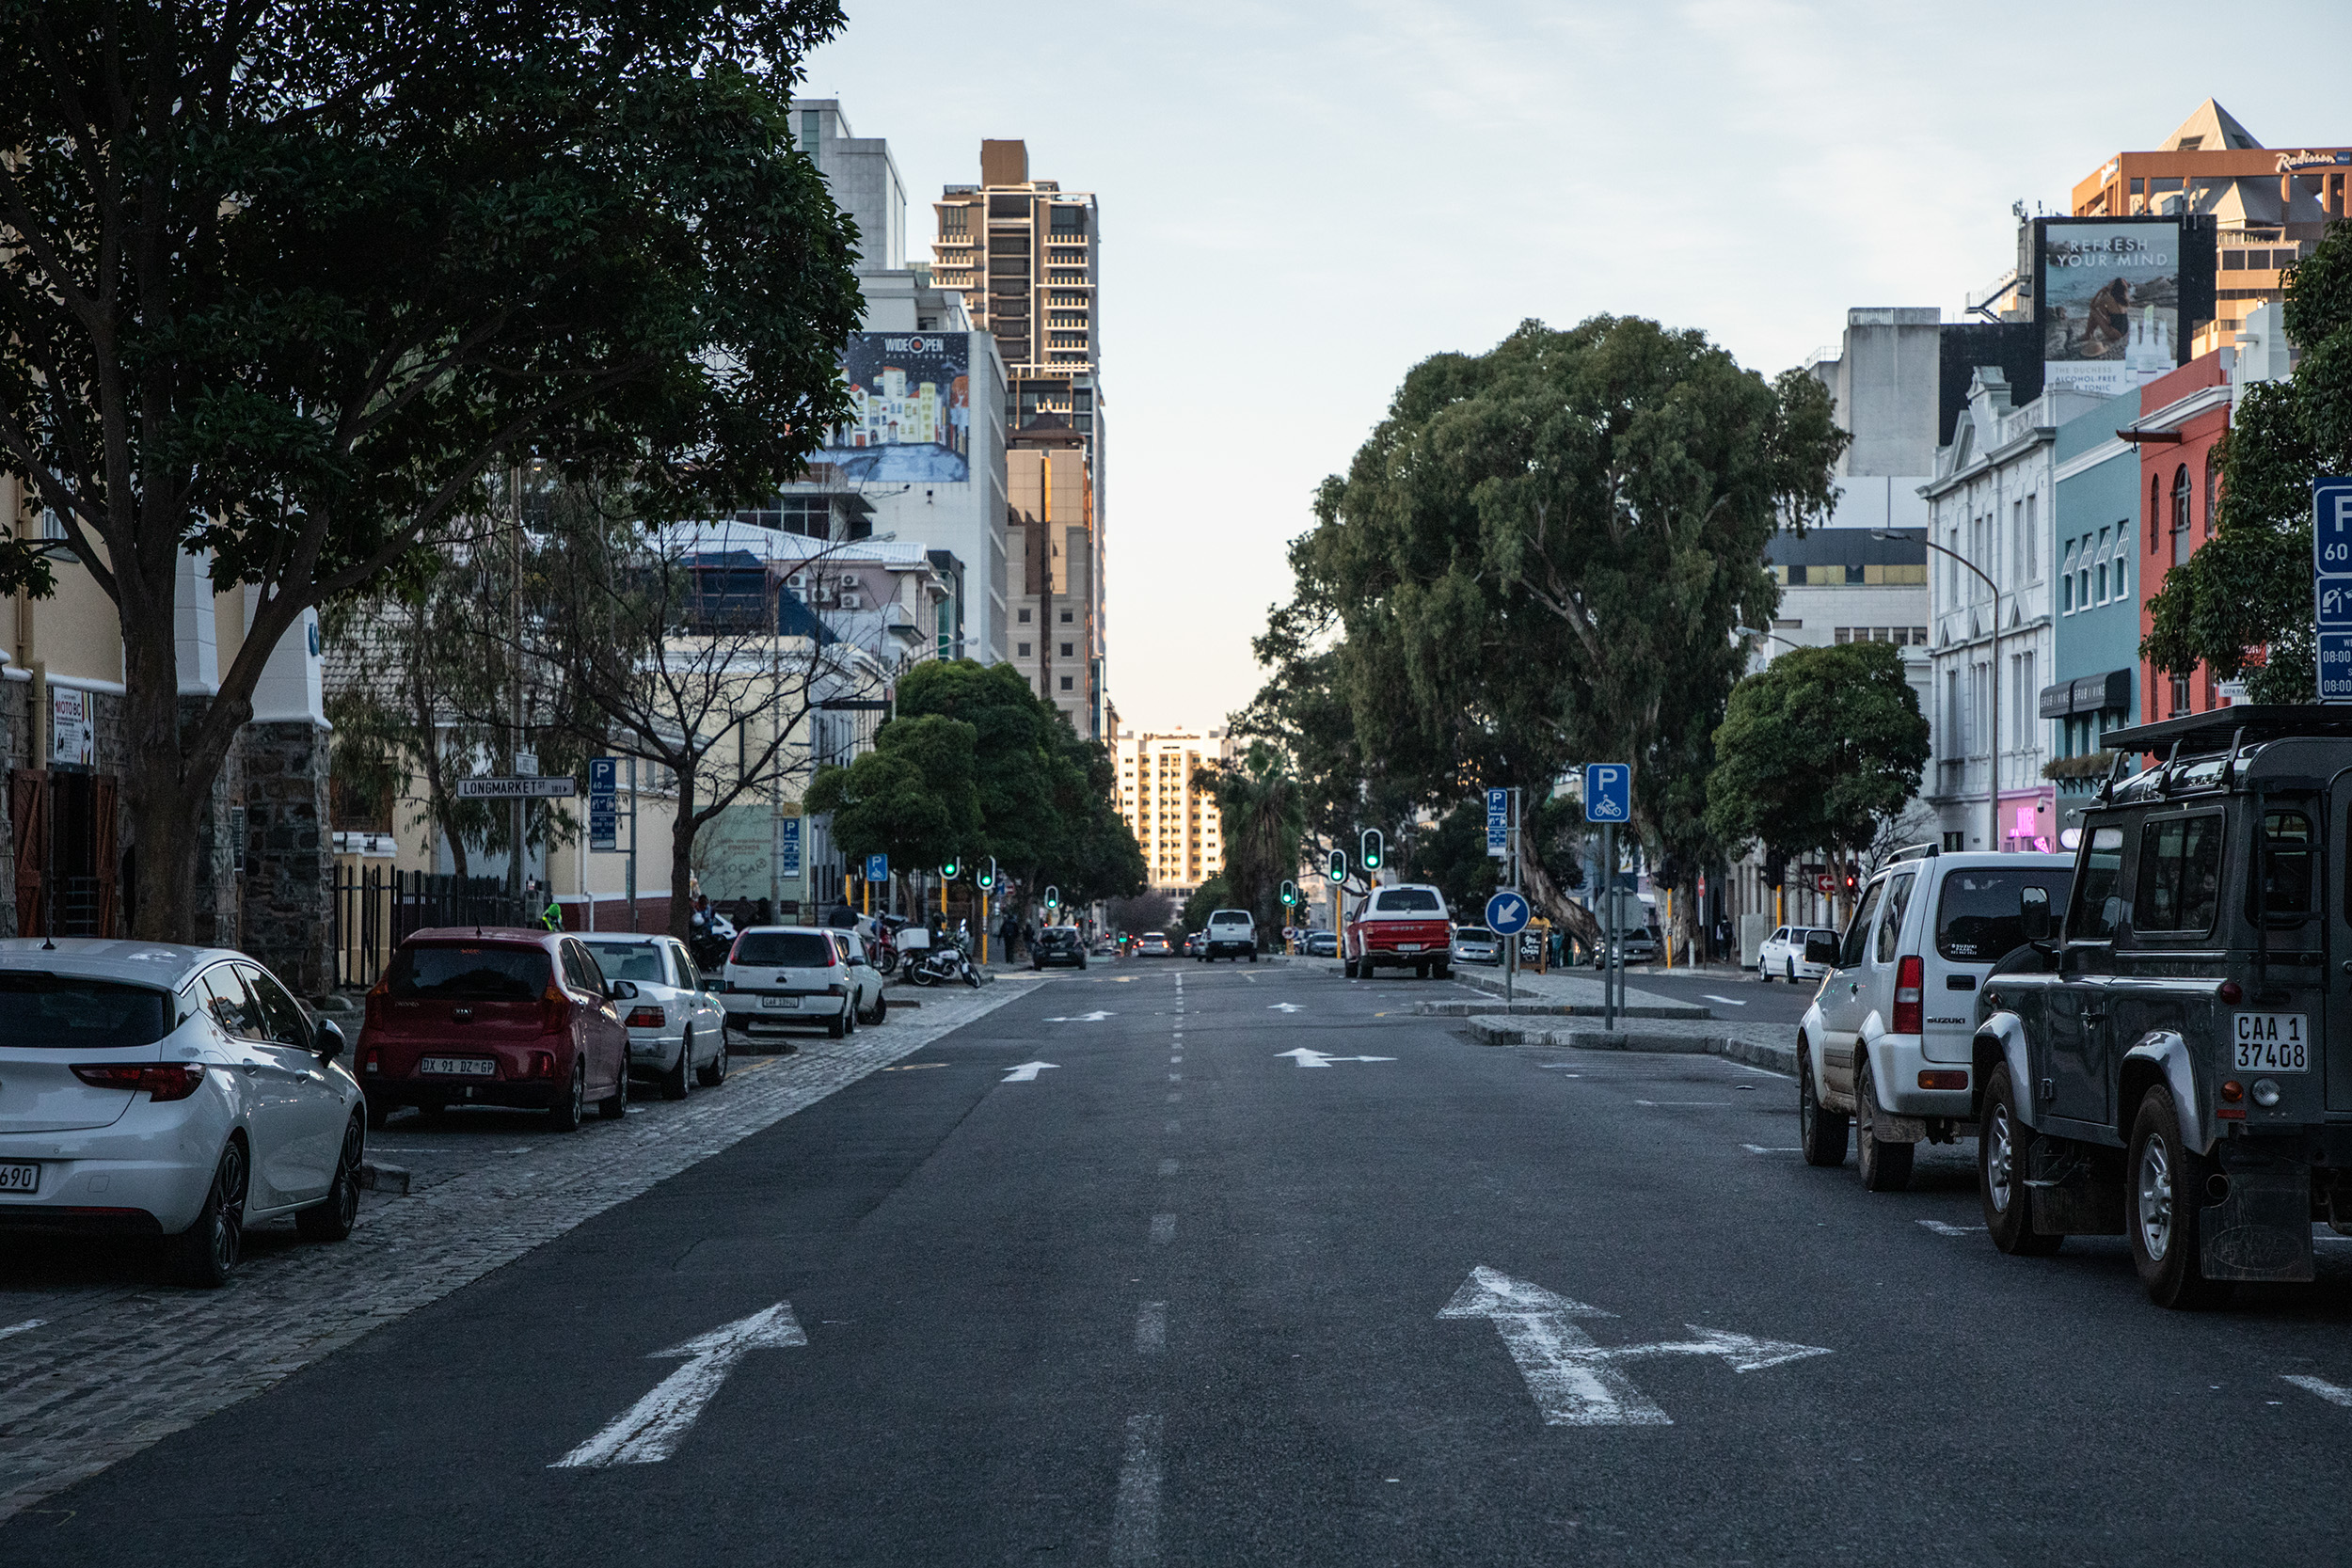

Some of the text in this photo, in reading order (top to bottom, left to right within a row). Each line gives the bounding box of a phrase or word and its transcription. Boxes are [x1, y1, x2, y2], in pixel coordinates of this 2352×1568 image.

[2275, 149, 2336, 173] Radisson
[2070, 239, 2148, 252] REFRESH
[2057, 253, 2168, 267] YOUR MIND
[2325, 543, 2348, 561] 60
[2323, 650, 2351, 663] 08:00
[2324, 679, 2352, 692] 08:00
[597, 763, 610, 778] P
[593, 782, 602, 790] 60
[1598, 768, 1618, 791] P
[464, 781, 537, 795] LONGMARKET
[538, 781, 546, 789] ST
[1493, 793, 1502, 803] P
[787, 821, 795, 832] P
[872, 856, 882, 867] P
[2238, 1016, 2300, 1041] CAA 1
[2238, 1043, 2305, 1068] 37408
[422, 1059, 494, 1073] DX 91 DZ GP
[0, 1167, 32, 1187] 690
